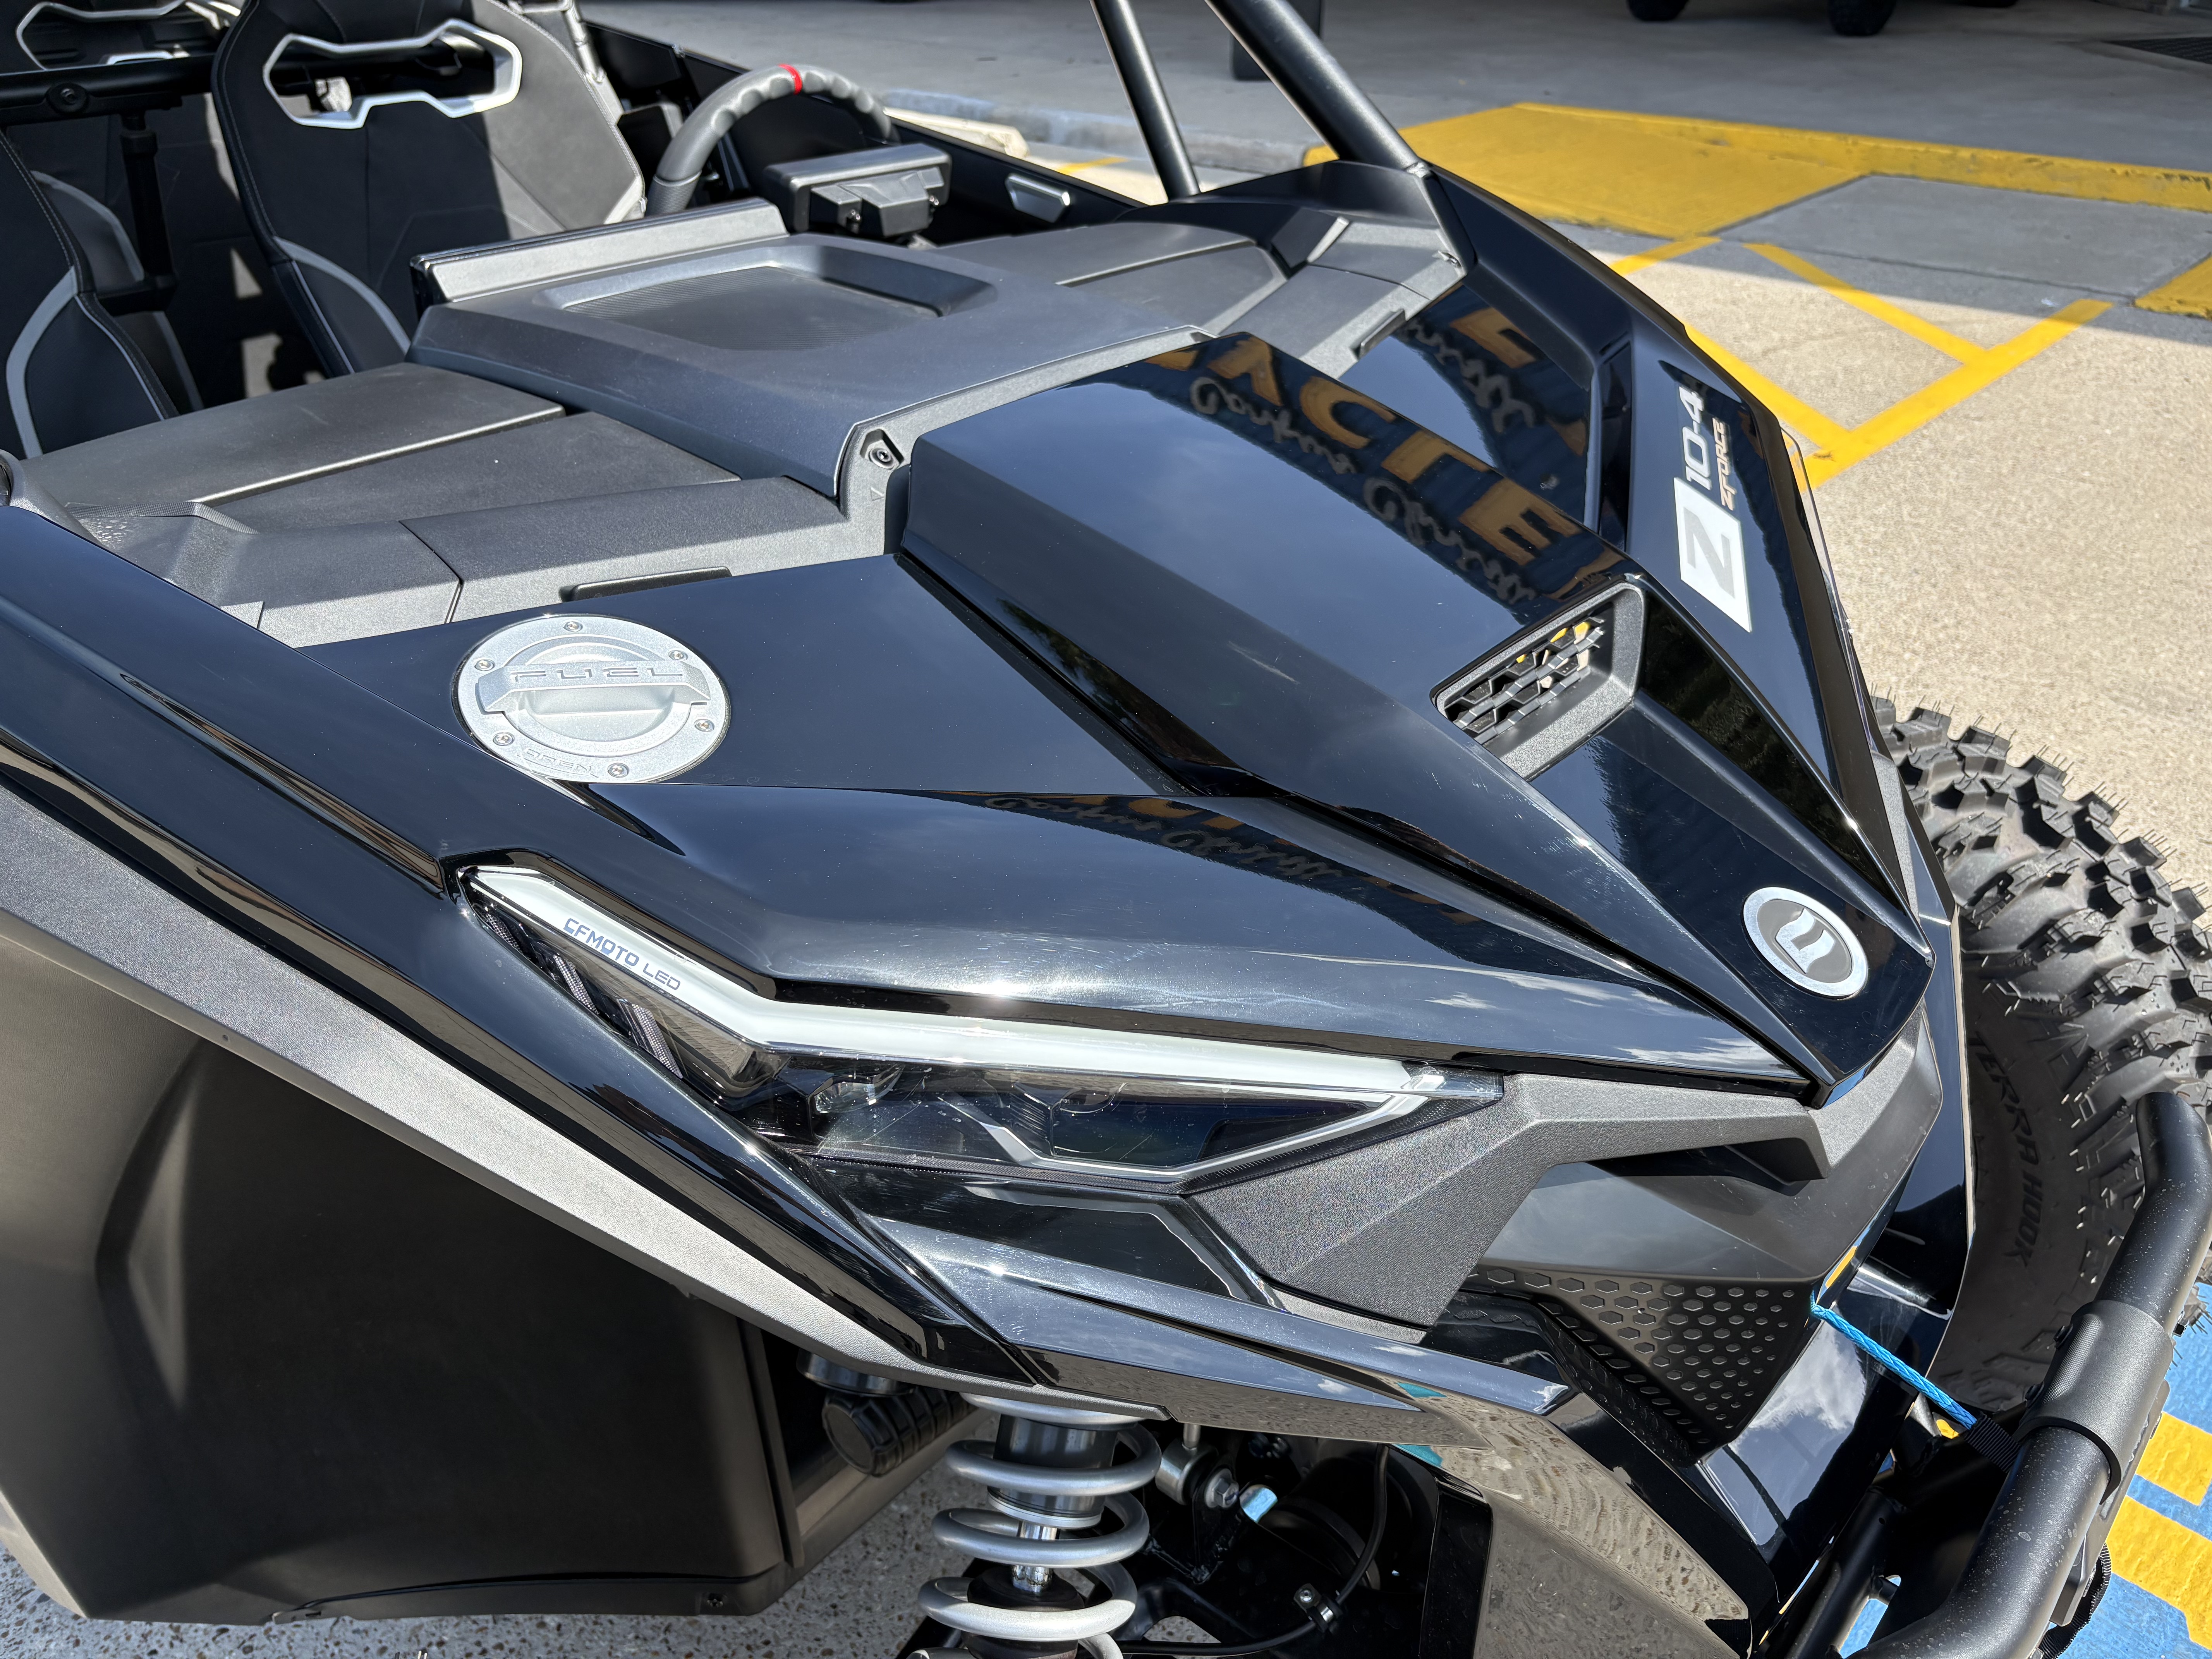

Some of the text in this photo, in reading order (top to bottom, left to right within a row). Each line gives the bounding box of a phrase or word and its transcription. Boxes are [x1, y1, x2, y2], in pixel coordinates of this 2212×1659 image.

[1712, 417, 1736, 511] ZFORCE
[509, 665, 684, 683] FUEL
[563, 917, 681, 991] CFMOTO LED
[1969, 1031, 2044, 1267] TERRA HOOK
